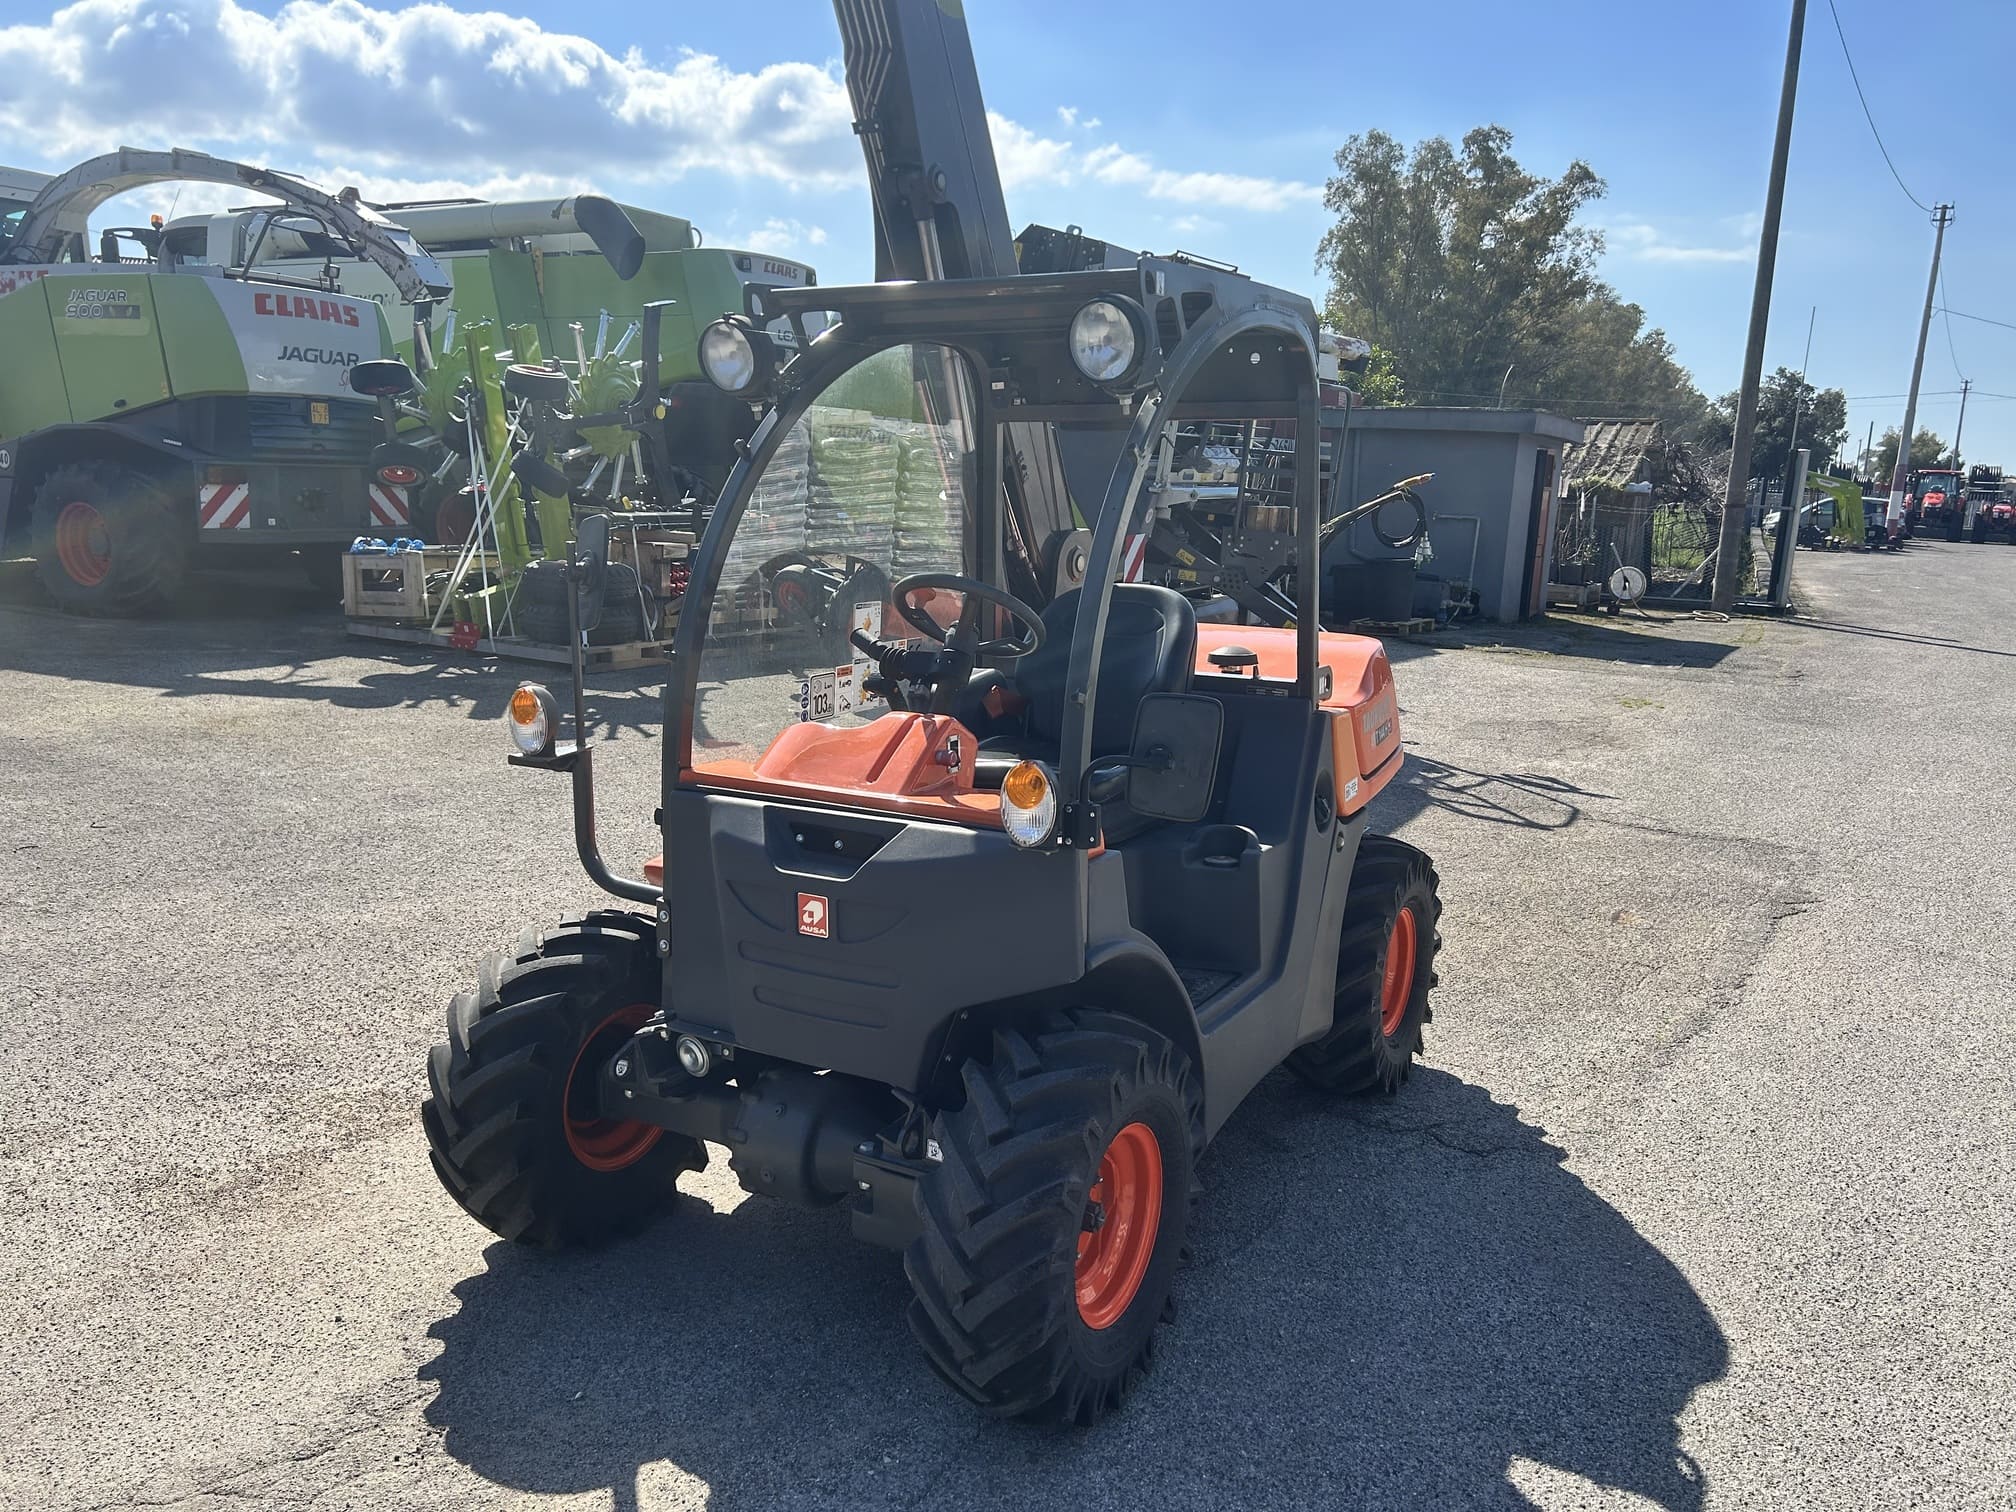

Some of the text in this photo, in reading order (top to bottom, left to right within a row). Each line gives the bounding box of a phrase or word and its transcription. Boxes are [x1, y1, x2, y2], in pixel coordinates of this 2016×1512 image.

[763, 261, 799, 280] CLAAS
[68, 288, 128, 303] JAGUAR
[254, 292, 360, 328] CLAAS
[277, 345, 360, 367] JAGUAR
[813, 693, 828, 715] 103
[800, 925, 826, 935] AUSA
